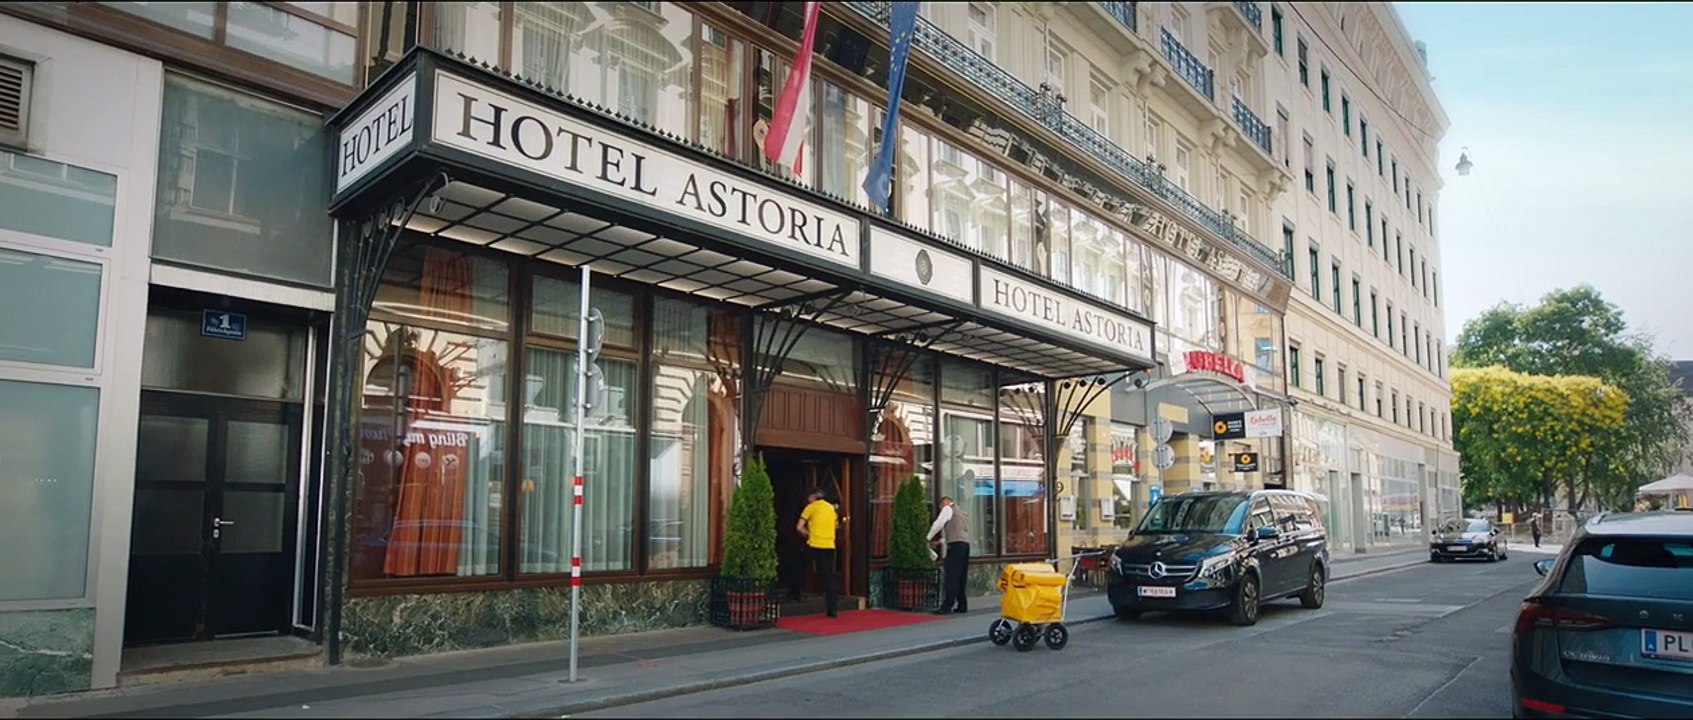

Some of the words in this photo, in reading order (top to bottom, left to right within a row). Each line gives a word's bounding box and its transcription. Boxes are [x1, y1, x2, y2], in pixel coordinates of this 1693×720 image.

[342, 94, 413, 178] HOTEL
[457, 92, 658, 197] HOTEL
[675, 173, 850, 257] ASTORIA
[219, 314, 231, 329] 1
[993, 278, 1066, 327] HOTEL
[1072, 308, 1144, 351] ASTORIA
